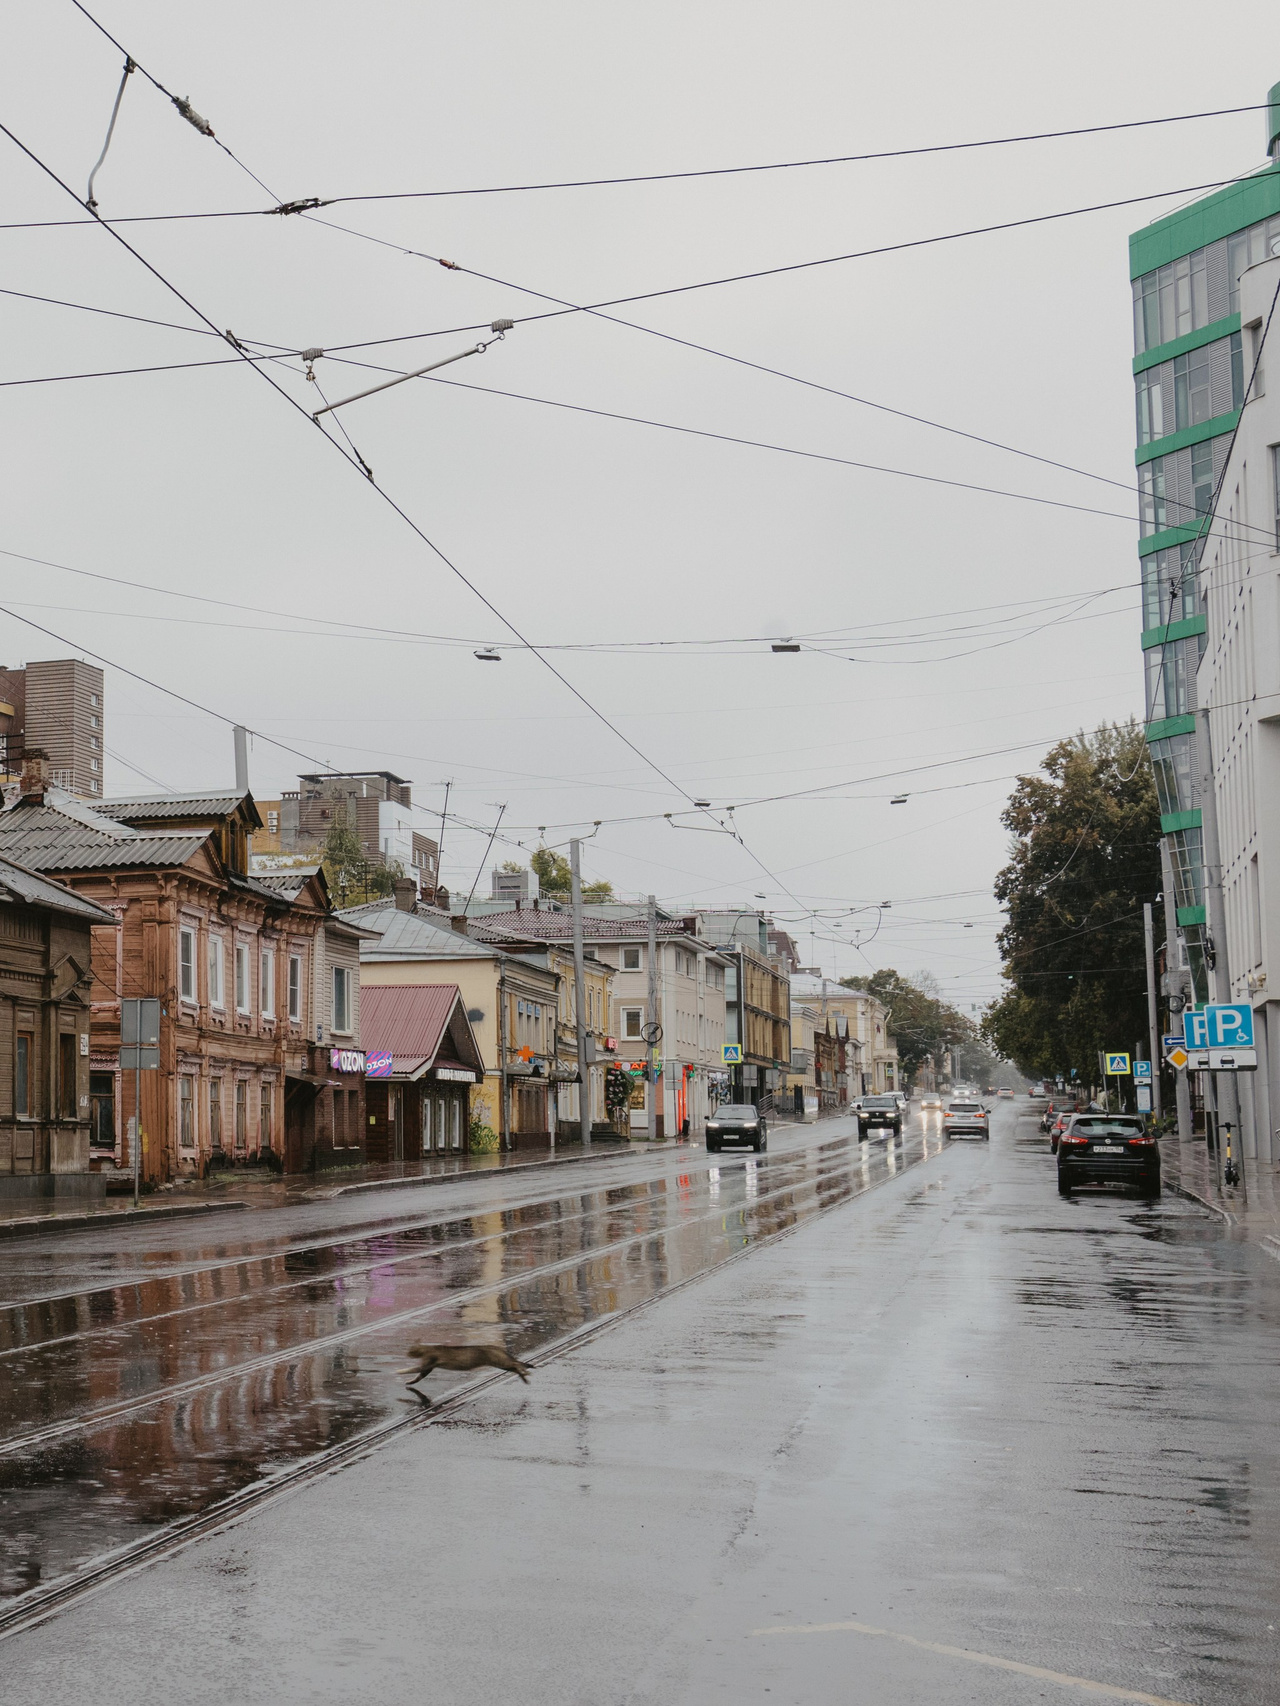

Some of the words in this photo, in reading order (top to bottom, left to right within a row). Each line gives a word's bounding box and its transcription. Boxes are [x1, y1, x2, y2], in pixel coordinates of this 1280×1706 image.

[1215, 1009, 1243, 1043] P
[341, 1051, 364, 1072] OZON
[366, 1057, 392, 1070] OZON
[1136, 1063, 1147, 1076] P
